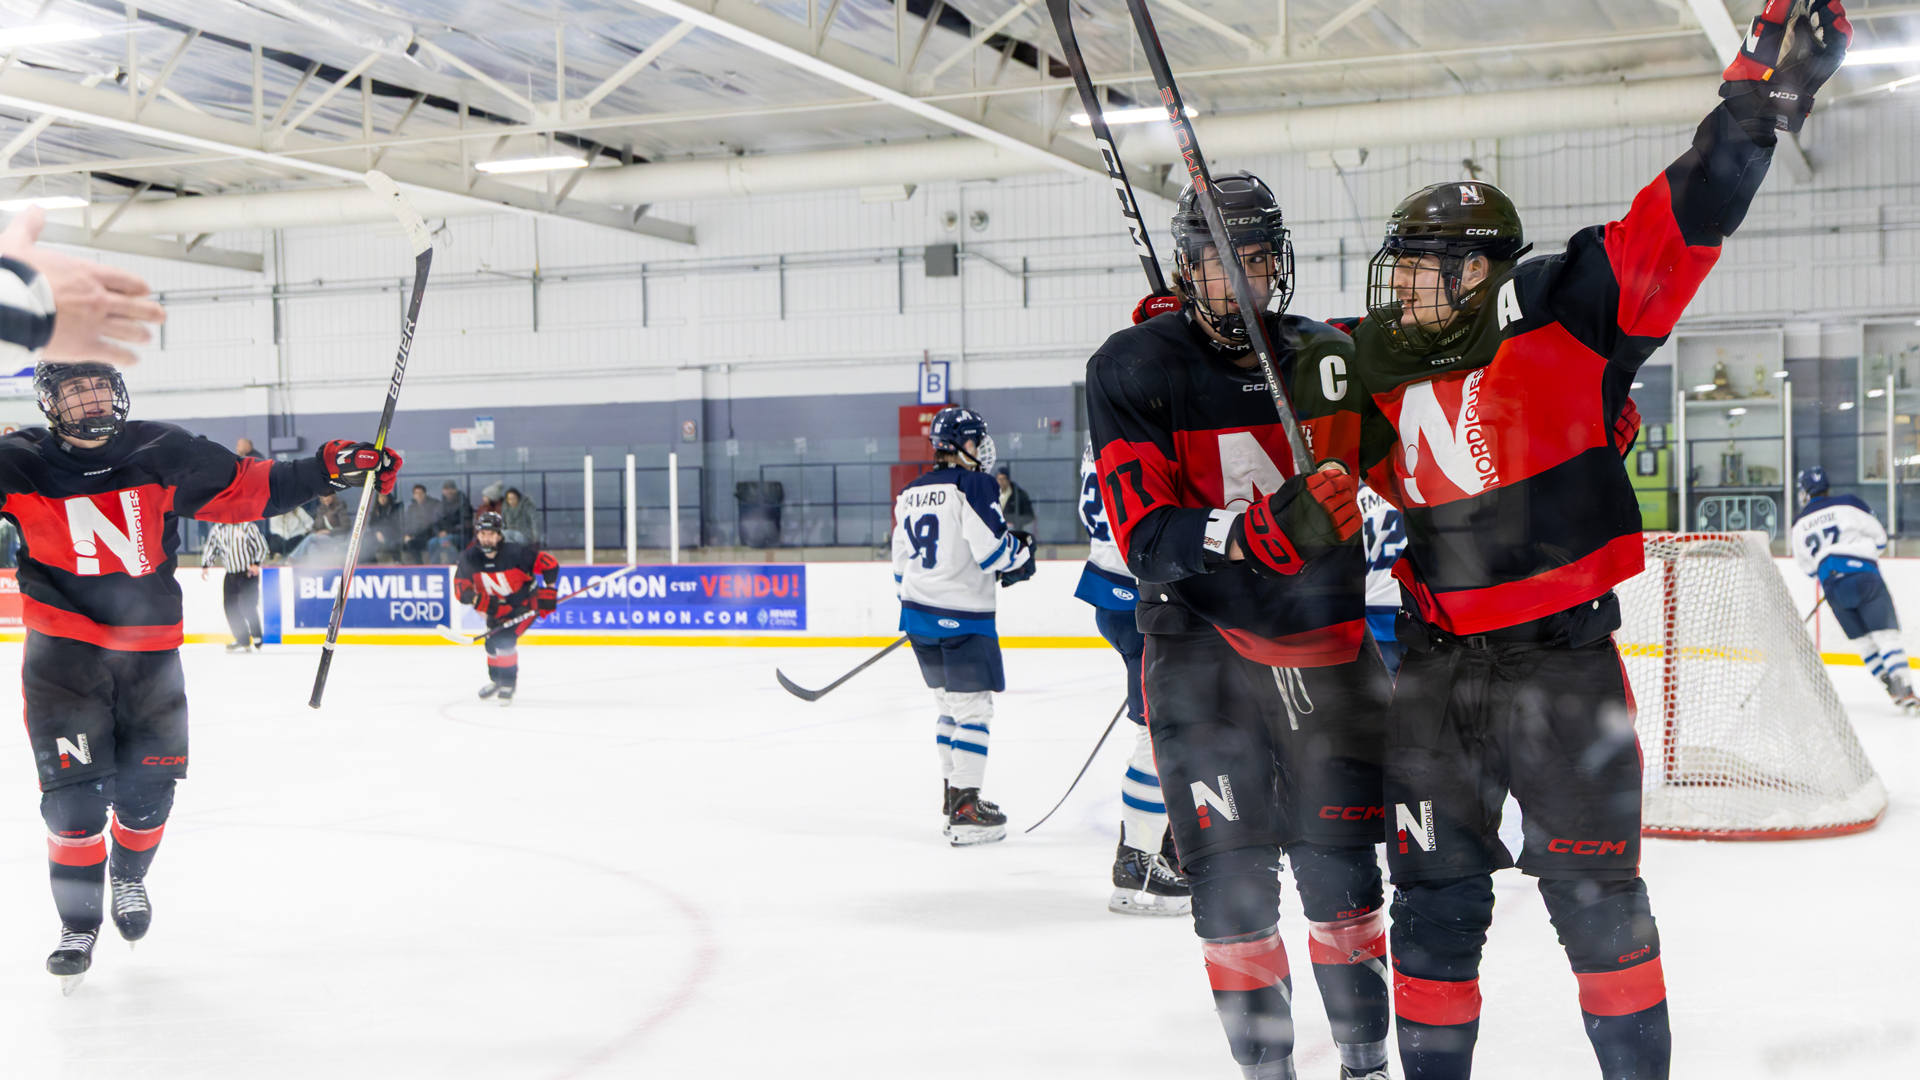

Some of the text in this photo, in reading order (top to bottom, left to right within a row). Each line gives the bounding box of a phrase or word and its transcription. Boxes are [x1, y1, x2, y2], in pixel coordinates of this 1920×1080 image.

[1769, 91, 1798, 100] CCM
[1158, 86, 1207, 194] SMOKE
[1096, 137, 1152, 258] CCM
[1226, 215, 1264, 226] CCM
[1465, 228, 1499, 236] CCM
[1460, 291, 1477, 305] CCM
[1497, 278, 1524, 331] A
[388, 317, 415, 400] BAUER
[927, 373, 941, 393] B
[1319, 355, 1348, 401] C
[1464, 368, 1500, 489] NORDIQUES
[1105, 459, 1156, 526] 17
[129, 489, 152, 575] NORDIQUES
[300, 574, 444, 599] BLAINVILLE
[556, 574, 799, 599] ALOMON C'EST VENDU!
[390, 601, 444, 621] FORD
[141, 756, 187, 766] CCM
[1221, 775, 1239, 820] NORDIQUES
[1318, 805, 1385, 821] CCM
[1424, 800, 1436, 851] NORDIQUES
[1547, 838, 1627, 855] CCM
[1336, 905, 1370, 920] CCM
[1618, 945, 1650, 963] CCM
